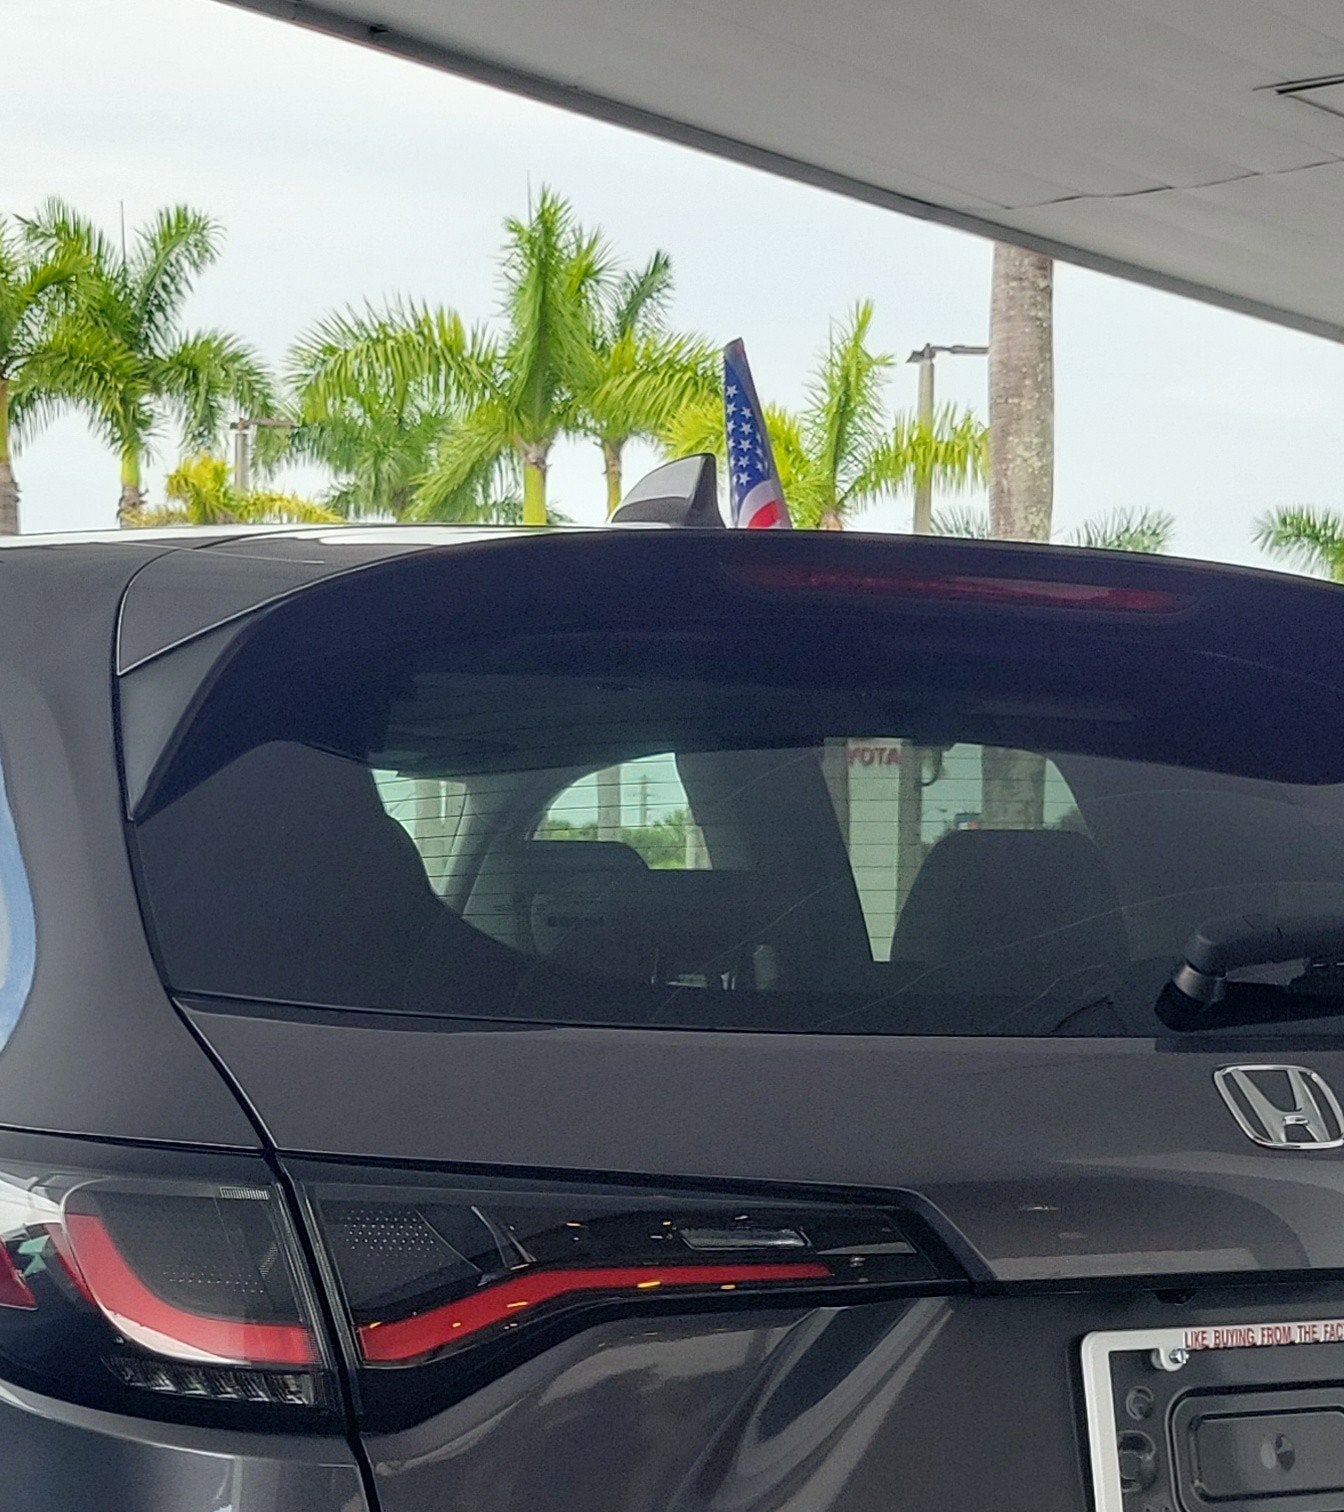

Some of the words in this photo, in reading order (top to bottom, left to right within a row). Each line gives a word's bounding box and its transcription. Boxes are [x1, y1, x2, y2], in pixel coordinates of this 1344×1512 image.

[1184, 1330, 1208, 1349] LIKE
[1213, 1328, 1255, 1347] BUYING
[1260, 1325, 1292, 1345] FROM
[1297, 1324, 1318, 1343] THE
